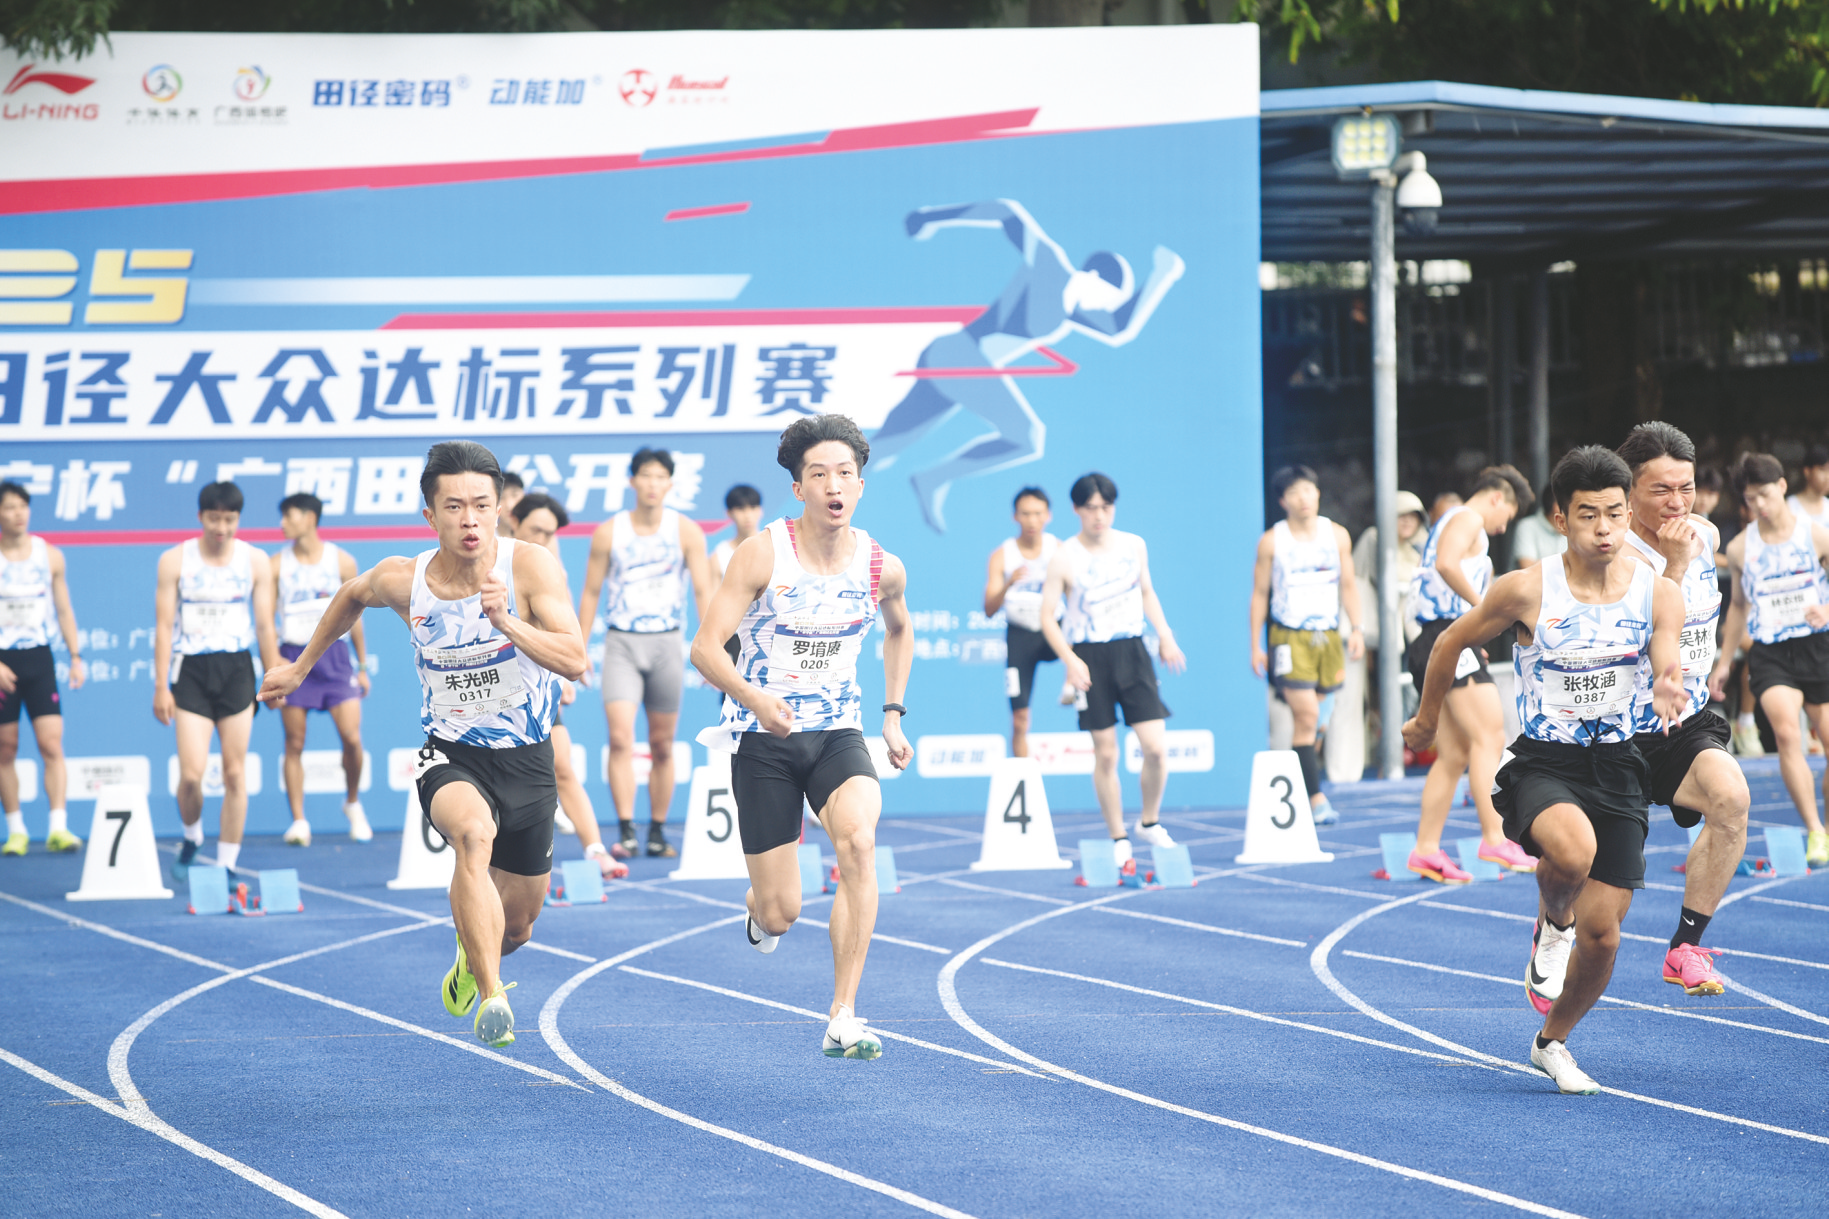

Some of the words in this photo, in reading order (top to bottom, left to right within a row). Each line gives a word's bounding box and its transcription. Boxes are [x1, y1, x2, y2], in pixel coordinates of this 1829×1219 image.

[312, 79, 451, 107] 田径密码
[488, 77, 587, 106] 动能加
[3, 103, 100, 121] LI-NING
[800, 659, 829, 670] 0205
[445, 668, 500, 691] 朱光明
[1563, 670, 1616, 692] 张牧涵
[459, 688, 491, 702] 0317
[1574, 691, 1606, 704] 0387
[1003, 780, 1032, 834] 4
[1269, 775, 1296, 829] 3
[705, 788, 733, 842] 5
[105, 810, 132, 867] 7
